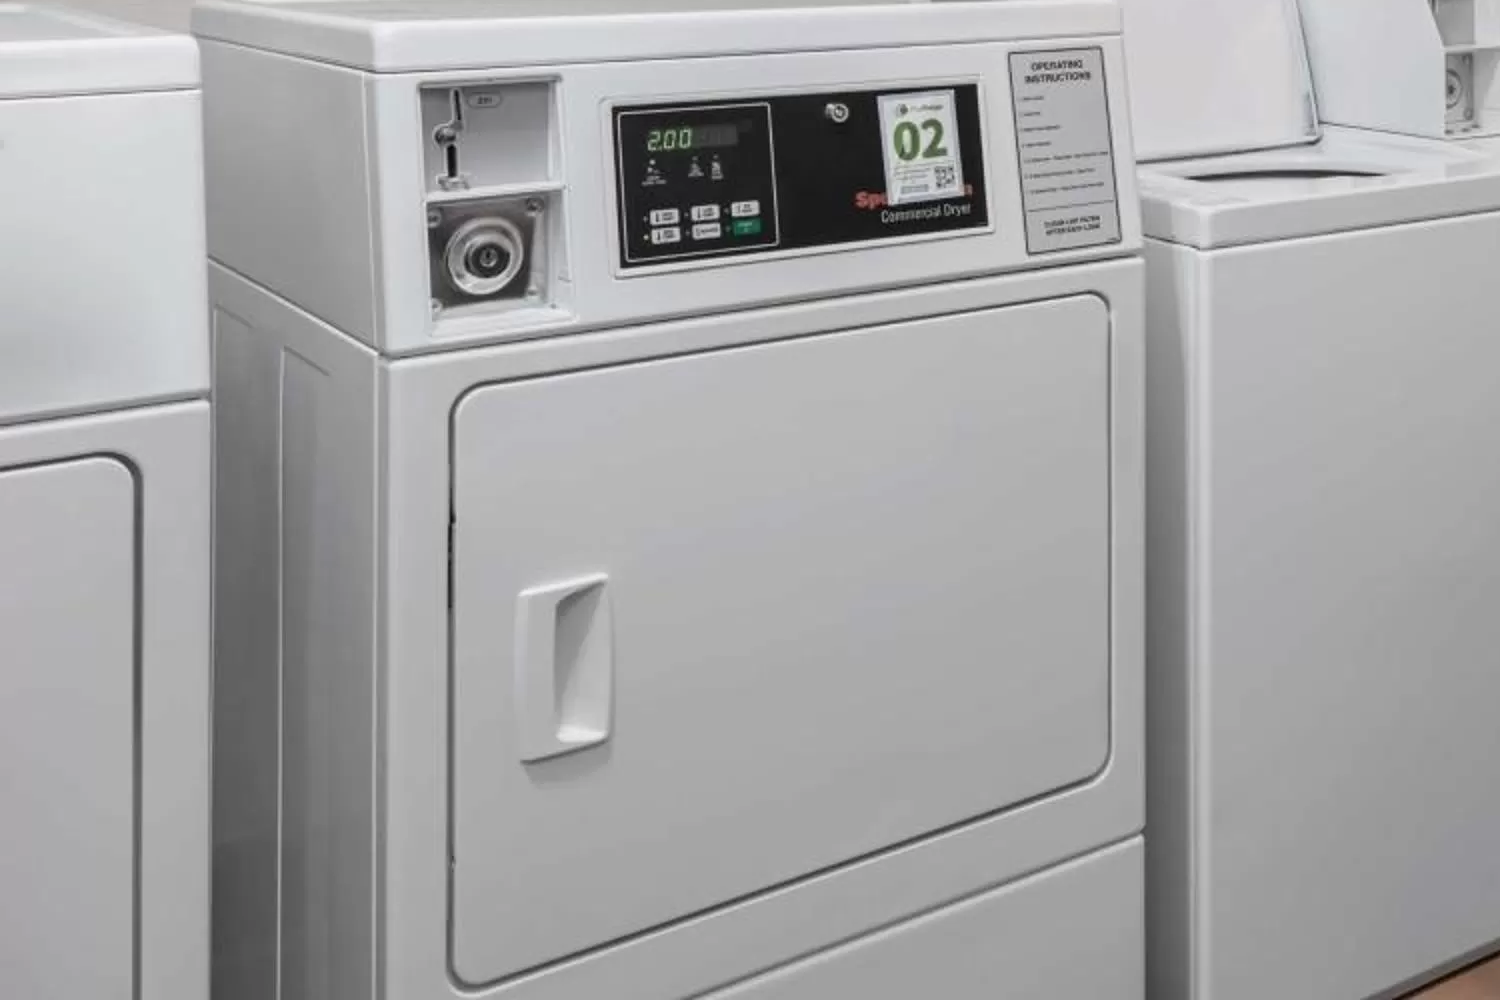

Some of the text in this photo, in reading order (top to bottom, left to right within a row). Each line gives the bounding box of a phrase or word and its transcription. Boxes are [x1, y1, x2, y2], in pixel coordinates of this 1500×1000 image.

[1030, 59, 1083, 72] OPERATING
[1024, 71, 1092, 84] INSTRUCTIONS
[893, 118, 949, 161] 02
[881, 203, 972, 224] Commercial Dryer
